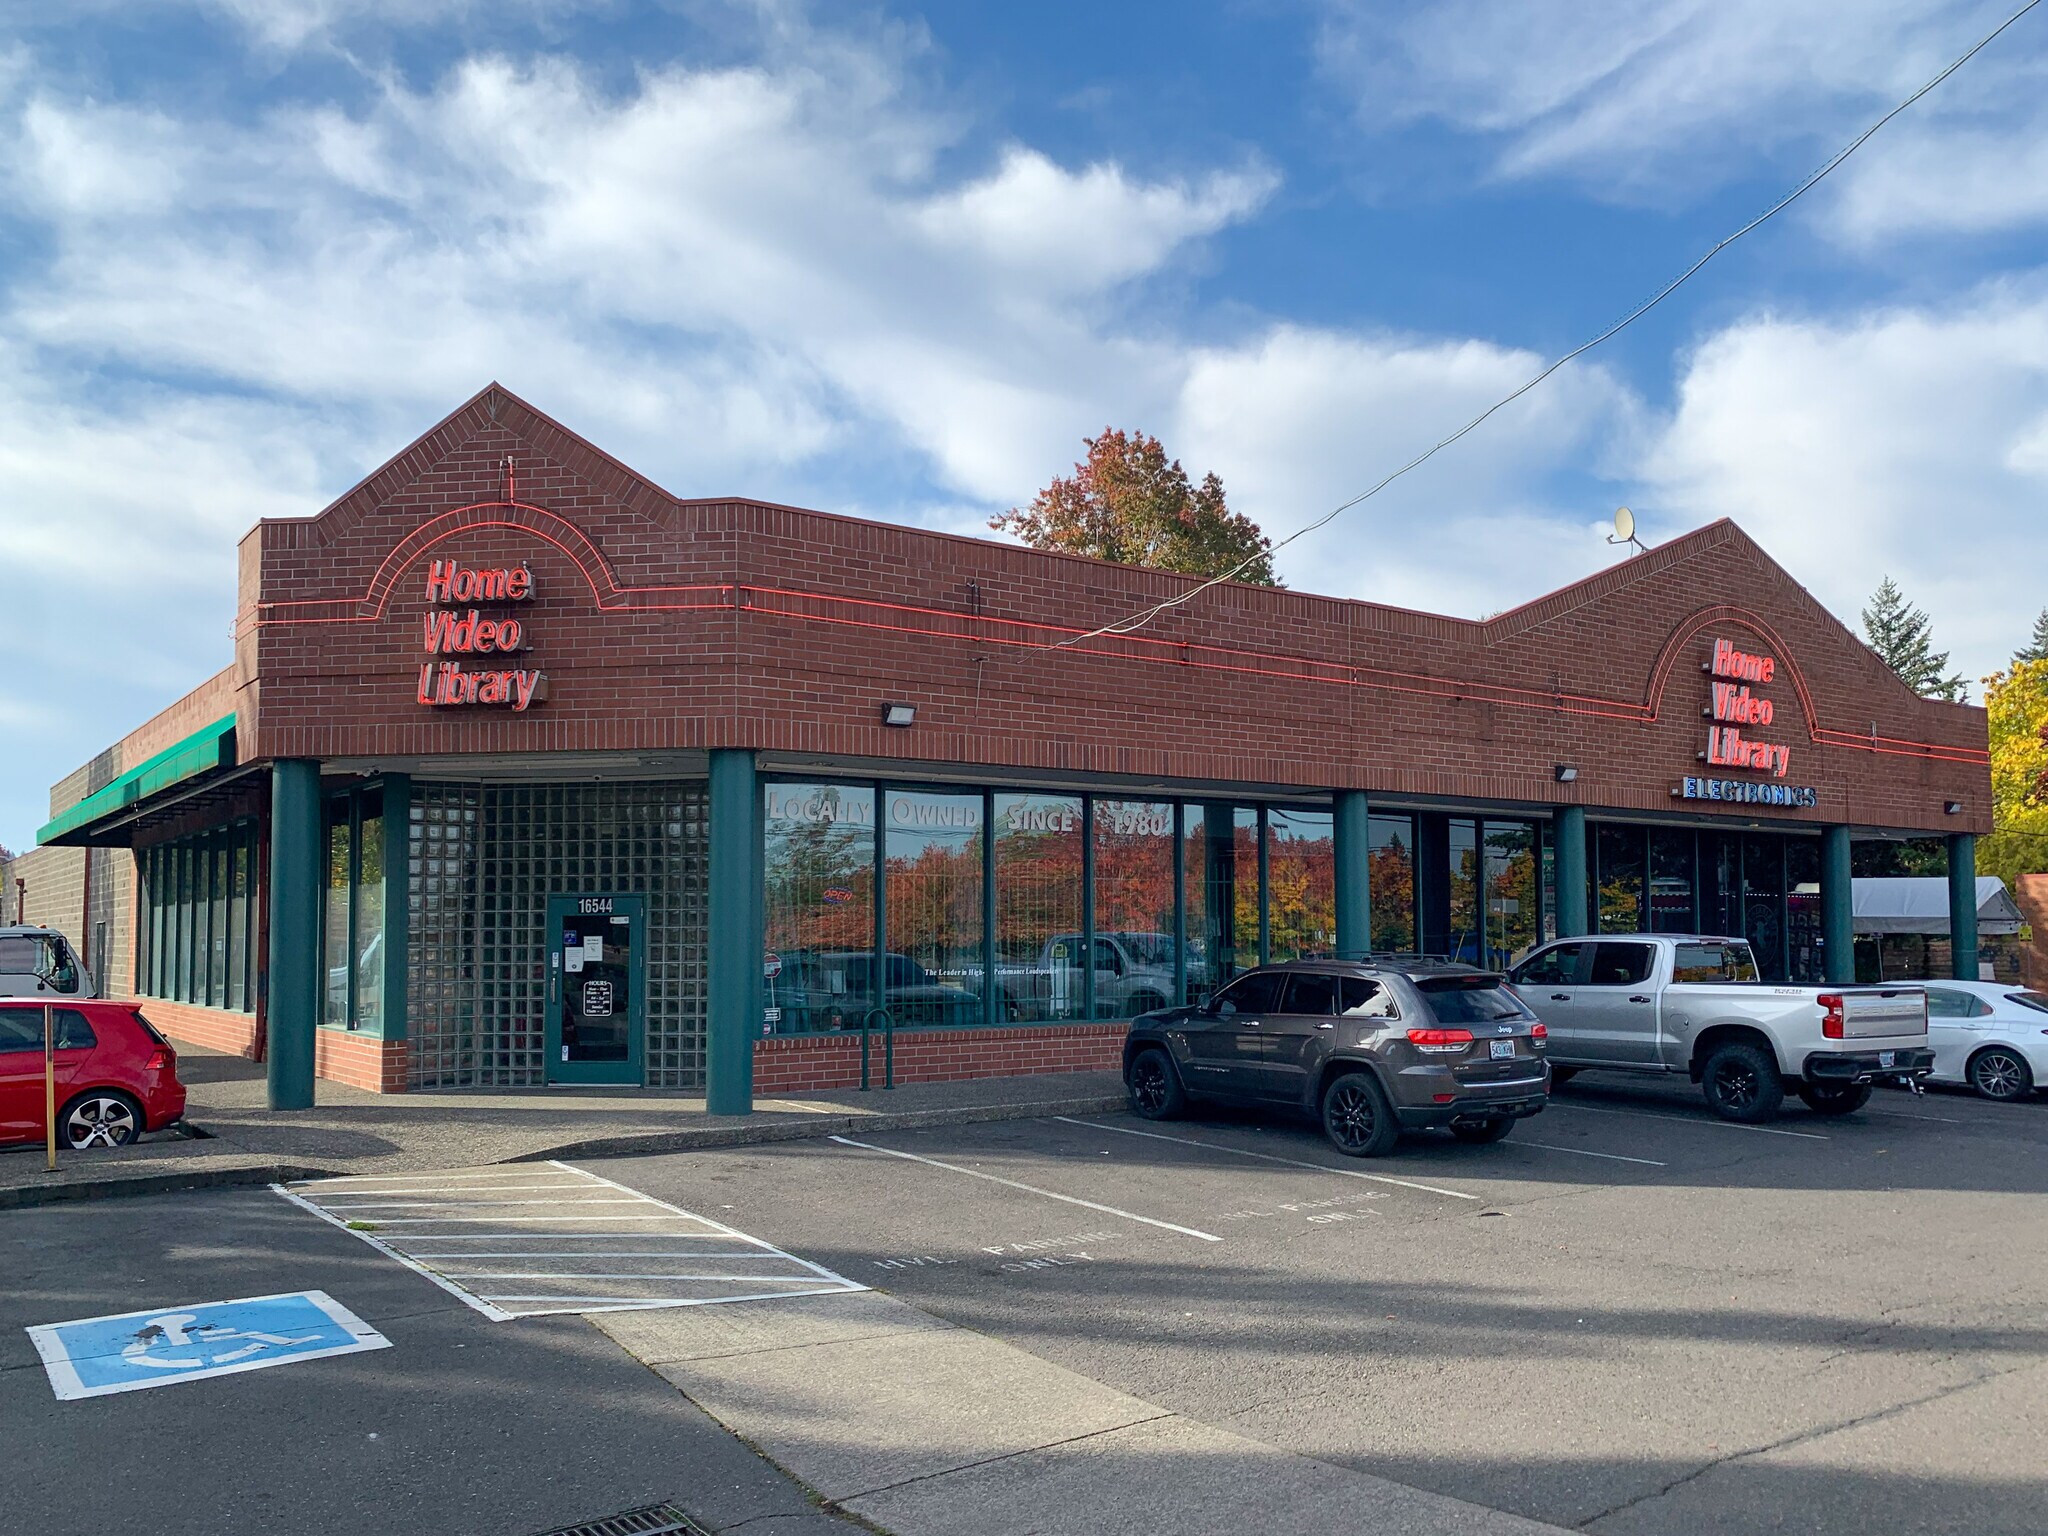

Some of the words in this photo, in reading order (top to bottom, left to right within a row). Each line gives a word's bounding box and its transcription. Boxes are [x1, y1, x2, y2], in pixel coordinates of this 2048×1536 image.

[426, 560, 532, 602] Home
[424, 609, 522, 654] Video
[1712, 638, 1775, 683] Home
[417, 661, 541, 712] Library
[1712, 682, 1774, 726] Video
[1707, 726, 1790, 777] Library
[769, 791, 870, 823] LOCALLY
[892, 798, 975, 827] OWNED
[1007, 804, 1073, 832] SINCE
[1112, 810, 1164, 836] 1980
[1683, 777, 1817, 808] ELECTRONICS
[578, 898, 613, 914] 16544
[824, 889, 853, 901] OPEN
[1498, 1026, 1513, 1034] Jeep
